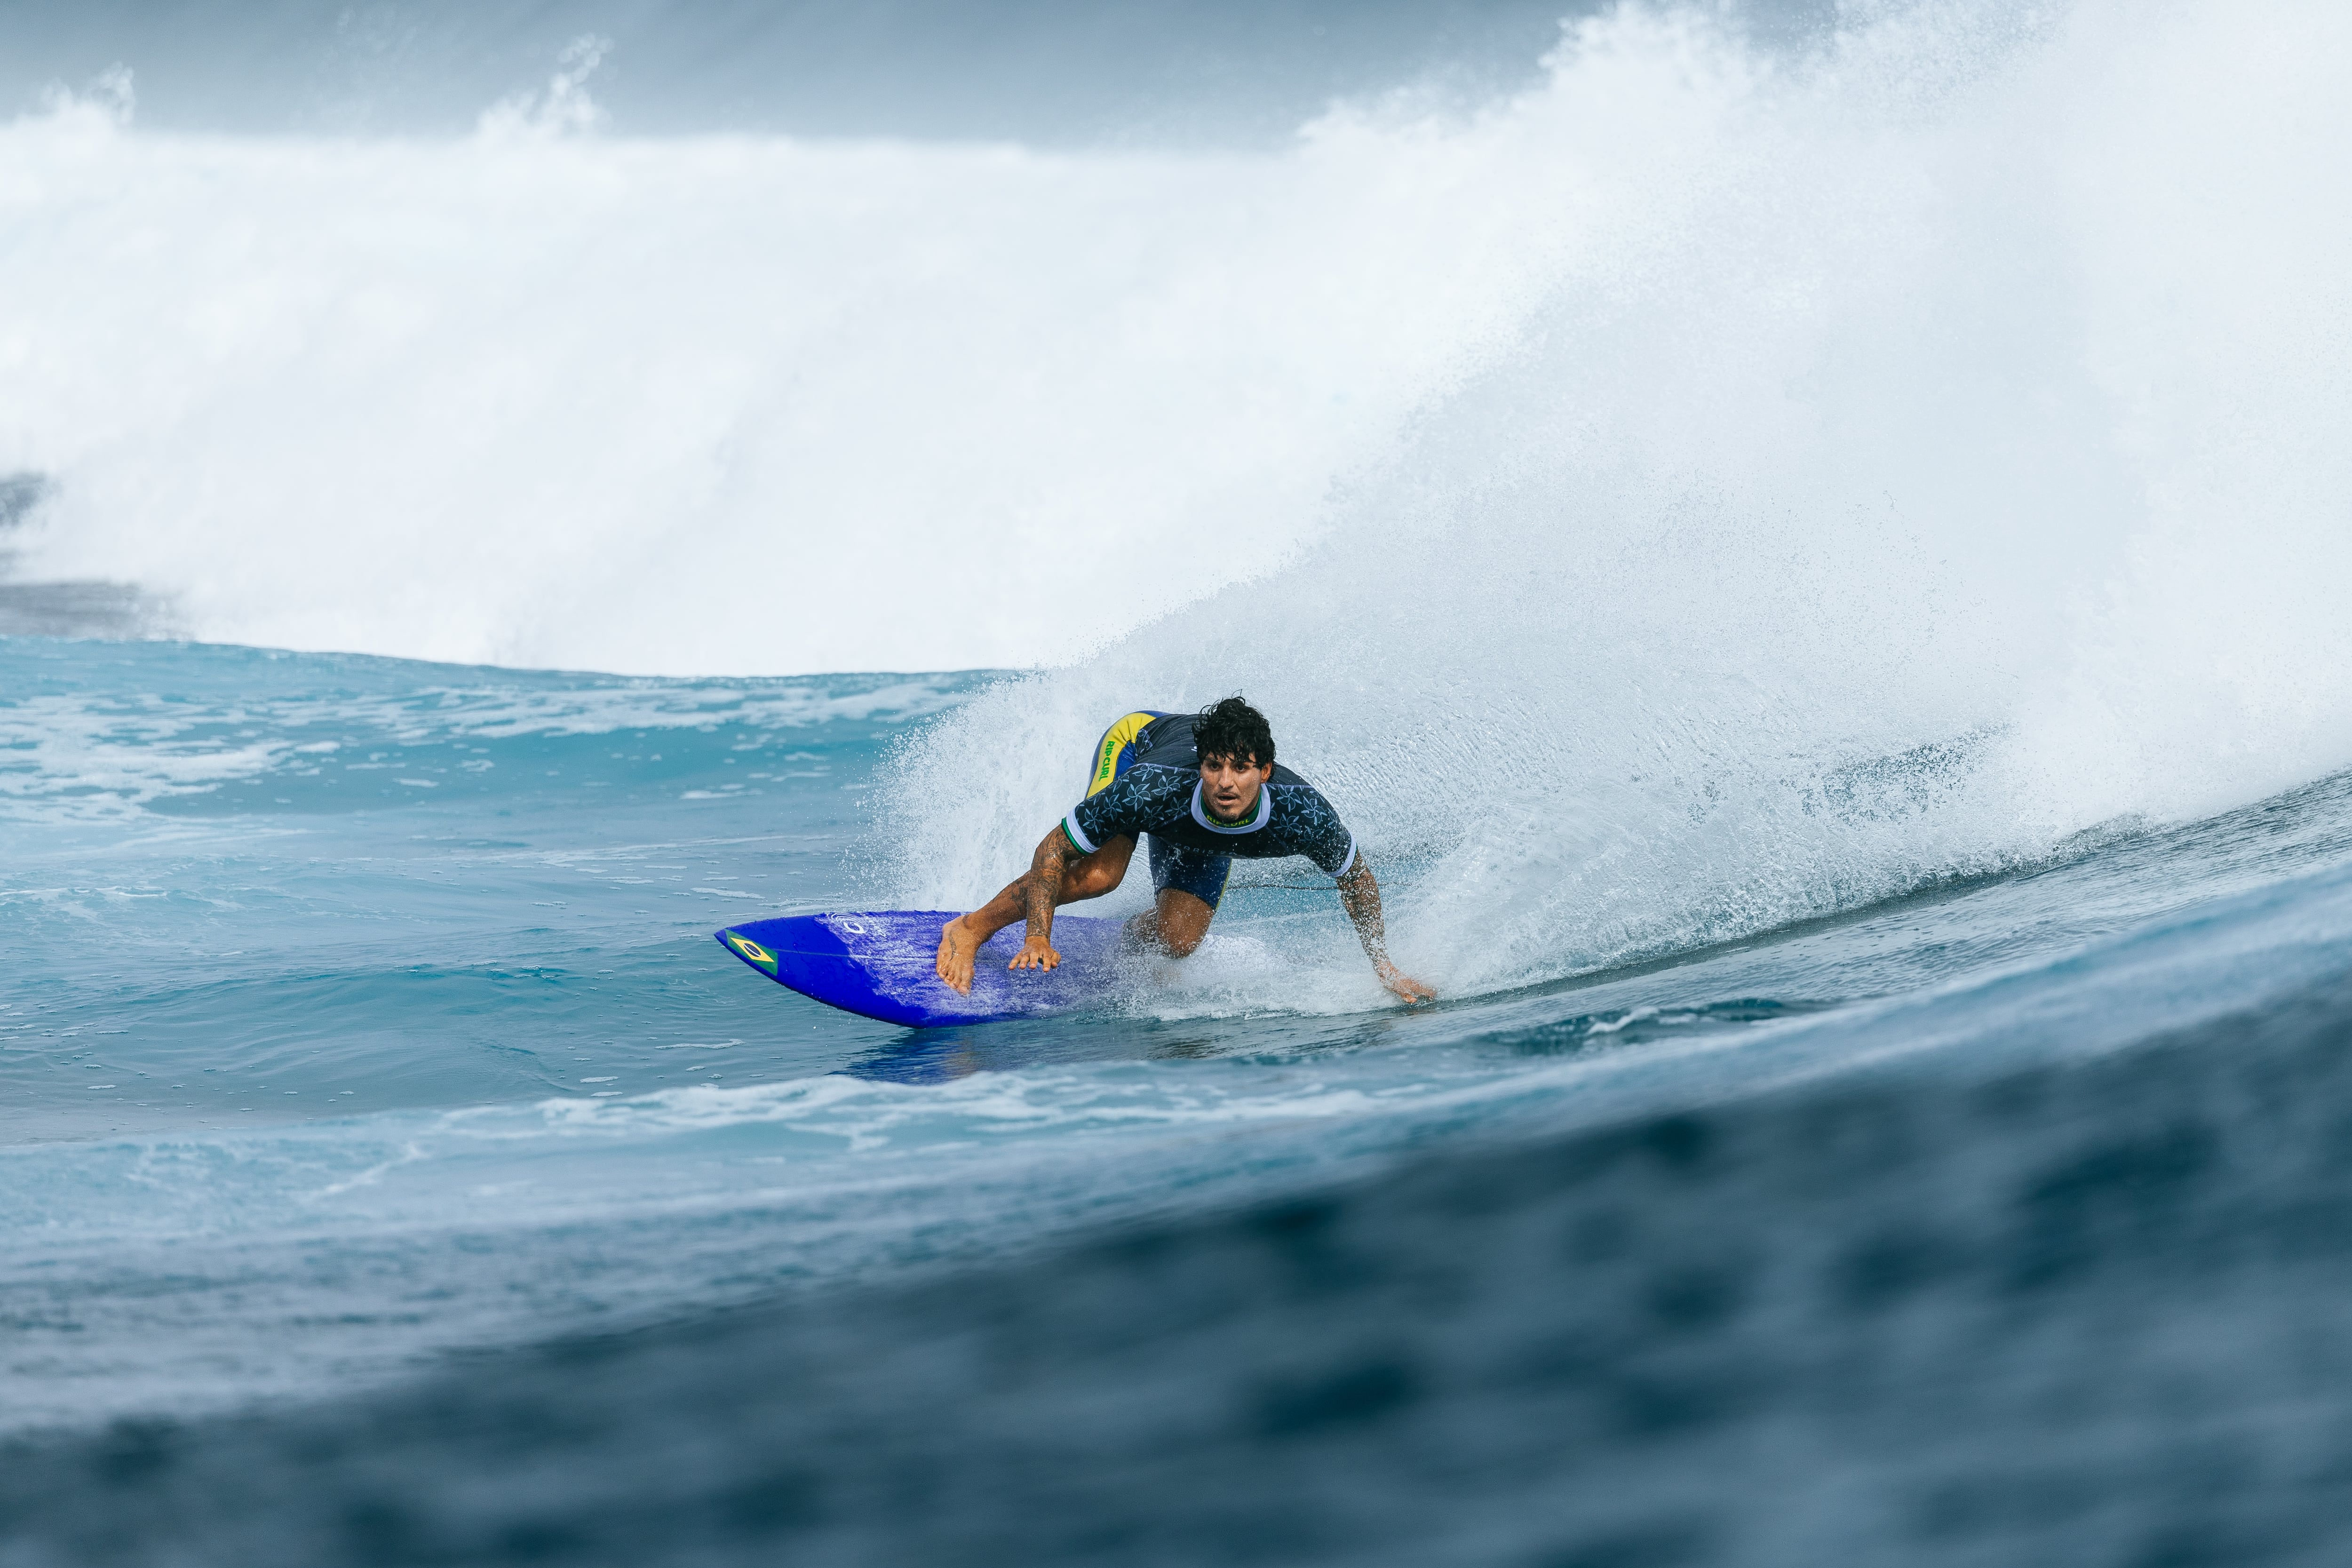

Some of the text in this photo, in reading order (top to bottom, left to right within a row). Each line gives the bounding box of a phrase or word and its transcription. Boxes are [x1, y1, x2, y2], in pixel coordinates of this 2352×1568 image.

[1098, 741, 1115, 781] RIP CURL
[1175, 842, 1214, 854] PARIS
